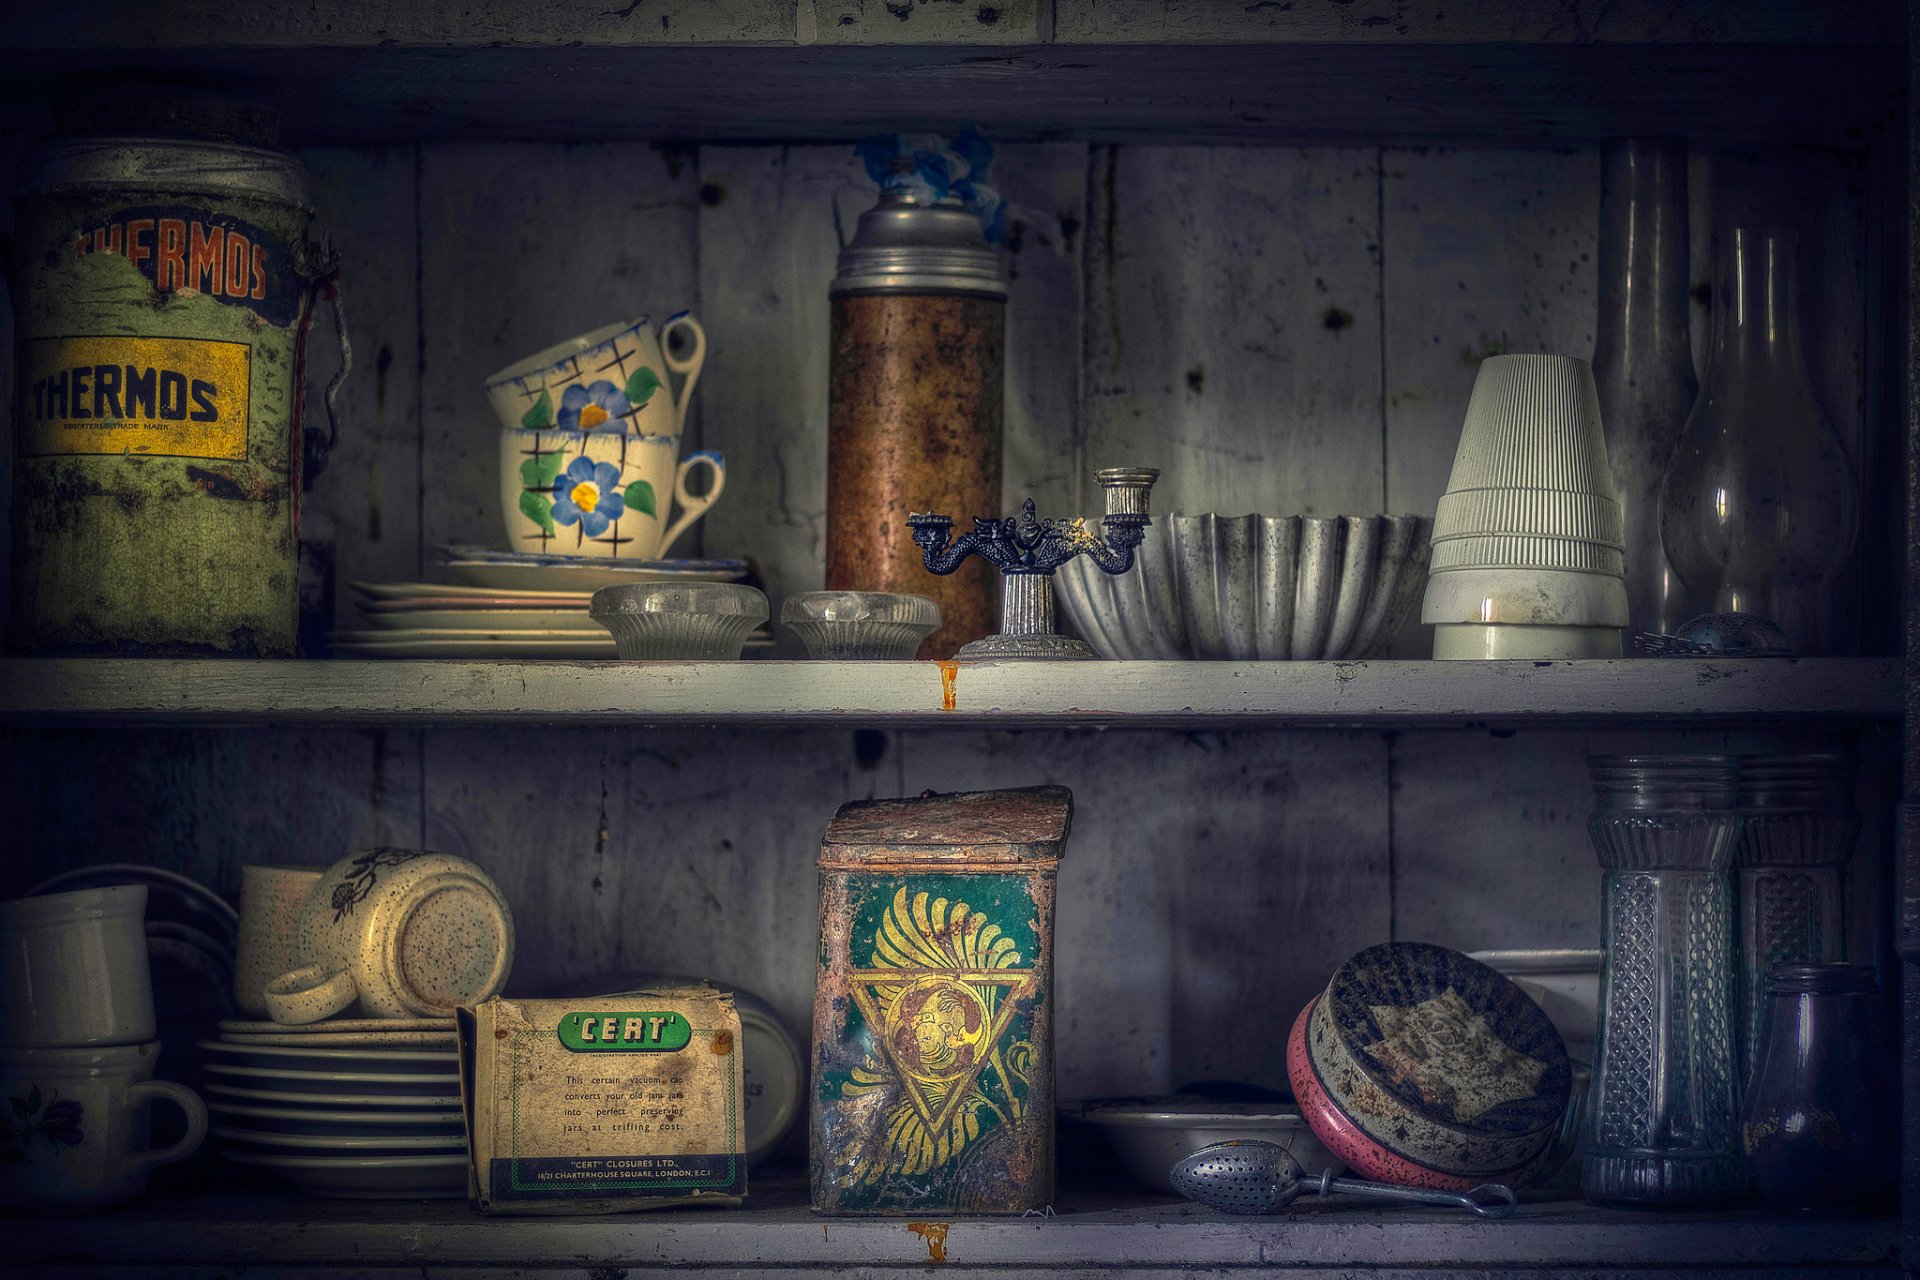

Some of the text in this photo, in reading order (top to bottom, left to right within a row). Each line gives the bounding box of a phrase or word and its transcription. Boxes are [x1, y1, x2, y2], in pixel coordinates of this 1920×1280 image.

[75, 218, 267, 300] ERMOS
[32, 364, 219, 423] THERMOS
[566, 1076, 583, 1085] This
[592, 1076, 620, 1084] certain
[630, 1076, 661, 1084] vacuum
[564, 1092, 601, 1100] converts
[605, 1093, 625, 1101] your
[648, 1092, 663, 1101] jam
[669, 1091, 684, 1101] jars
[596, 1107, 626, 1118] perfect
[640, 1107, 684, 1117] preserving
[563, 1125, 583, 1134] jars
[612, 1122, 650, 1133] trifling
[659, 1123, 684, 1131] cost.
[606, 1160, 653, 1168] CLOSURES
[554, 1171, 619, 1180] CHARTERHOUSE
